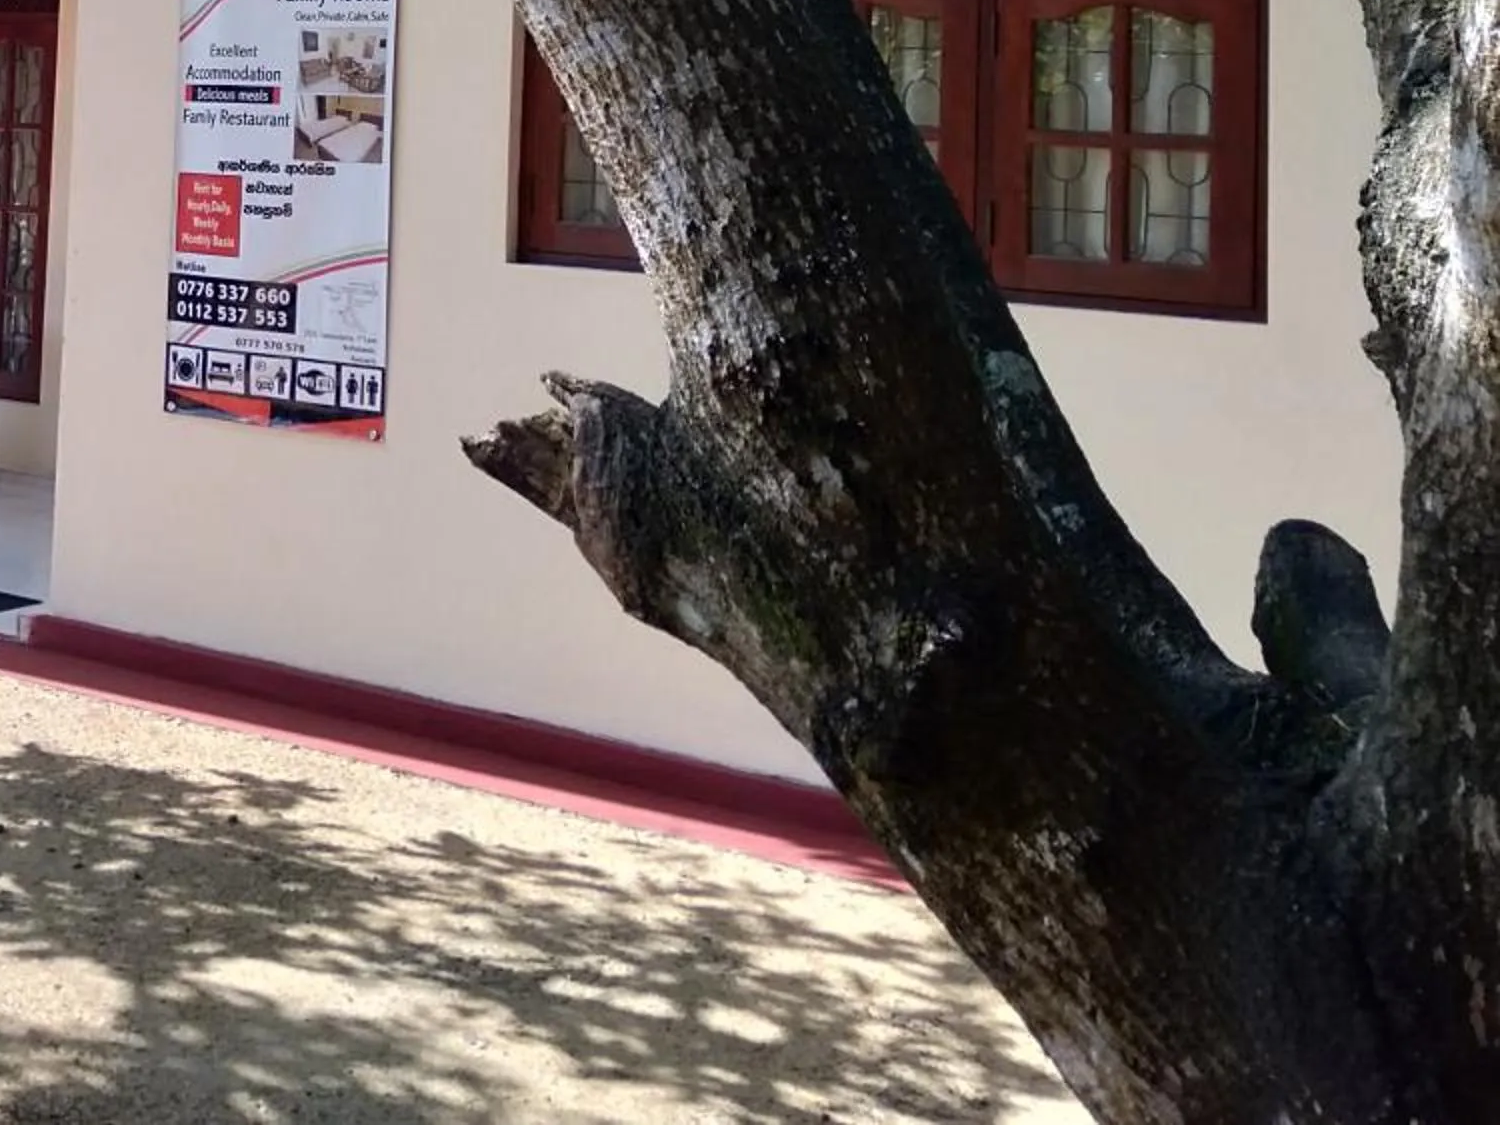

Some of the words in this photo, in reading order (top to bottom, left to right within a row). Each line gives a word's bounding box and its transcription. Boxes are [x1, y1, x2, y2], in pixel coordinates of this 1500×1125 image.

[209, 43, 258, 57] Excellent
[185, 64, 281, 81] Accommodation
[183, 108, 216, 128] Family
[220, 109, 290, 127] Restaurant
[177, 279, 215, 298] 0776
[217, 283, 249, 302] 337
[255, 287, 291, 305] 660
[177, 300, 212, 320] 0112
[217, 304, 248, 323] 537
[254, 309, 287, 328] 553
